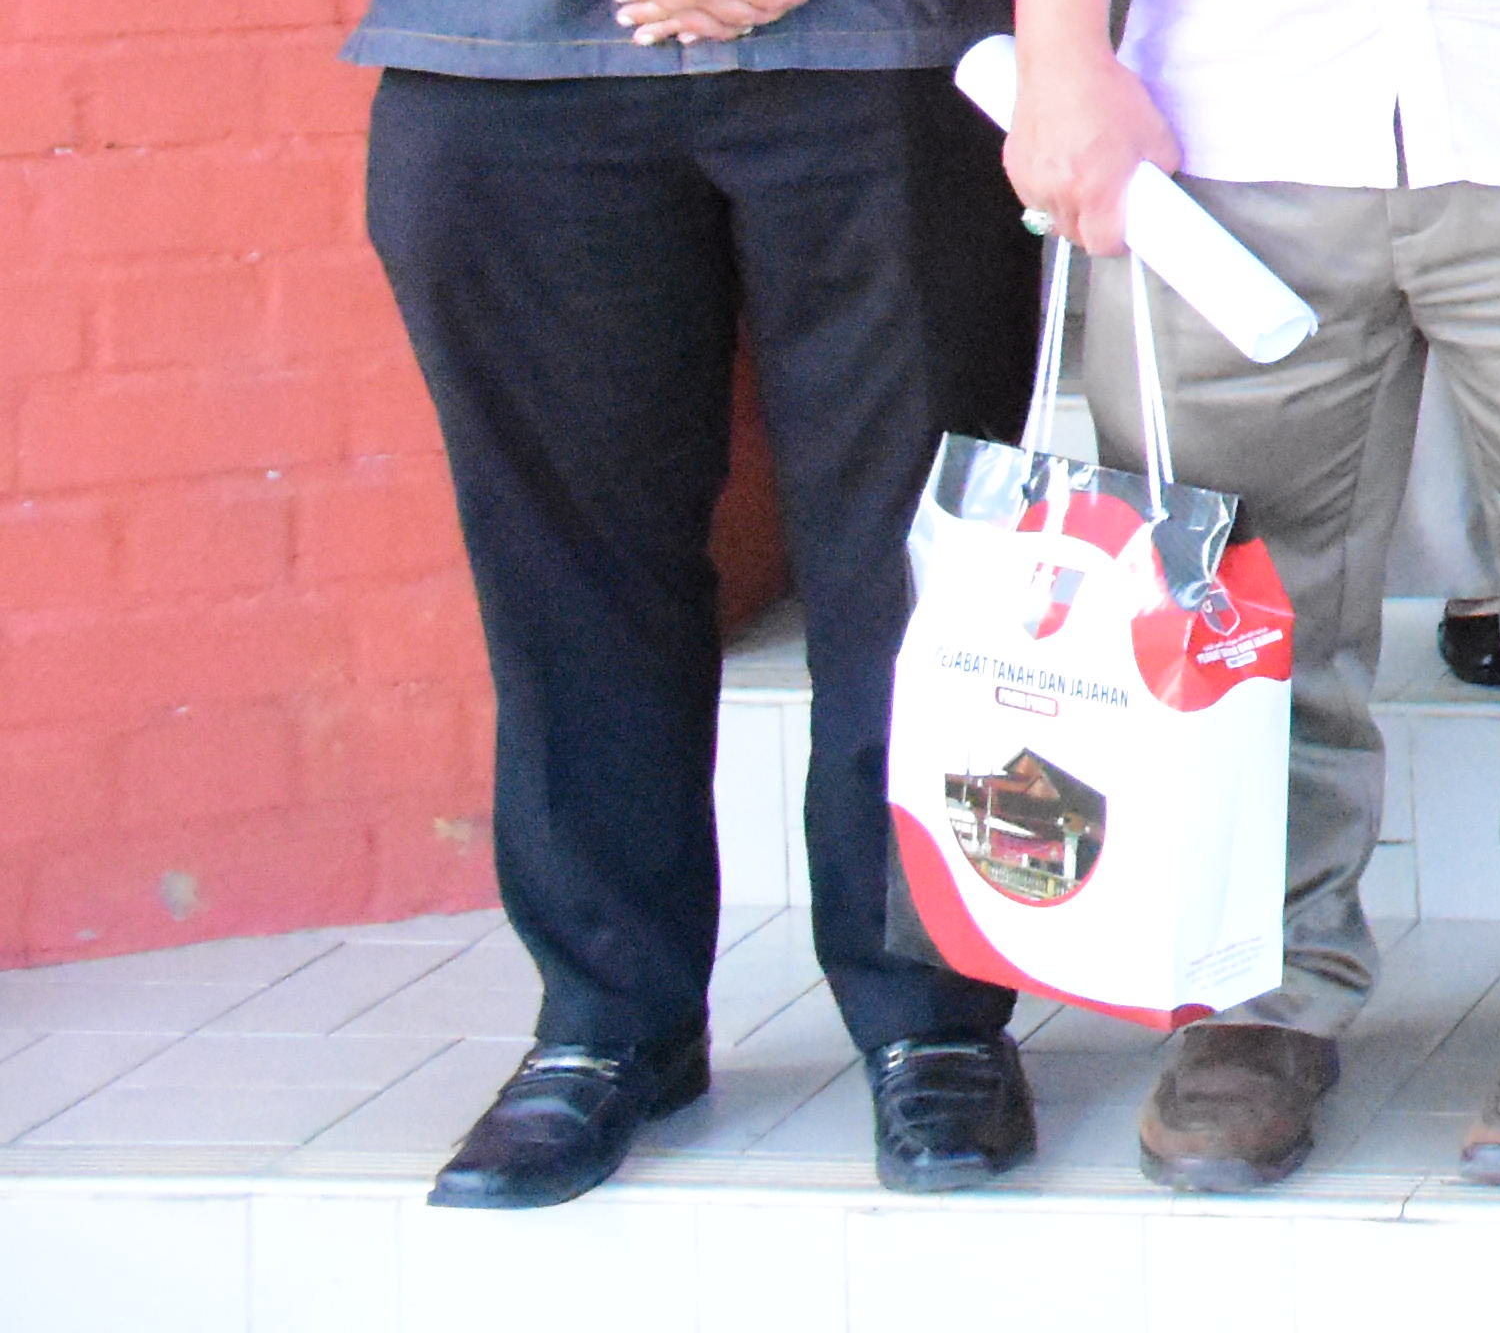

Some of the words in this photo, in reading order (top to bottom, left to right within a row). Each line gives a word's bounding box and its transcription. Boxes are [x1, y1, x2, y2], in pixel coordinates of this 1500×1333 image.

[991, 658, 1035, 687] TANAH
[1038, 669, 1067, 694] DAN
[1069, 678, 1130, 709] JAJAHAN
